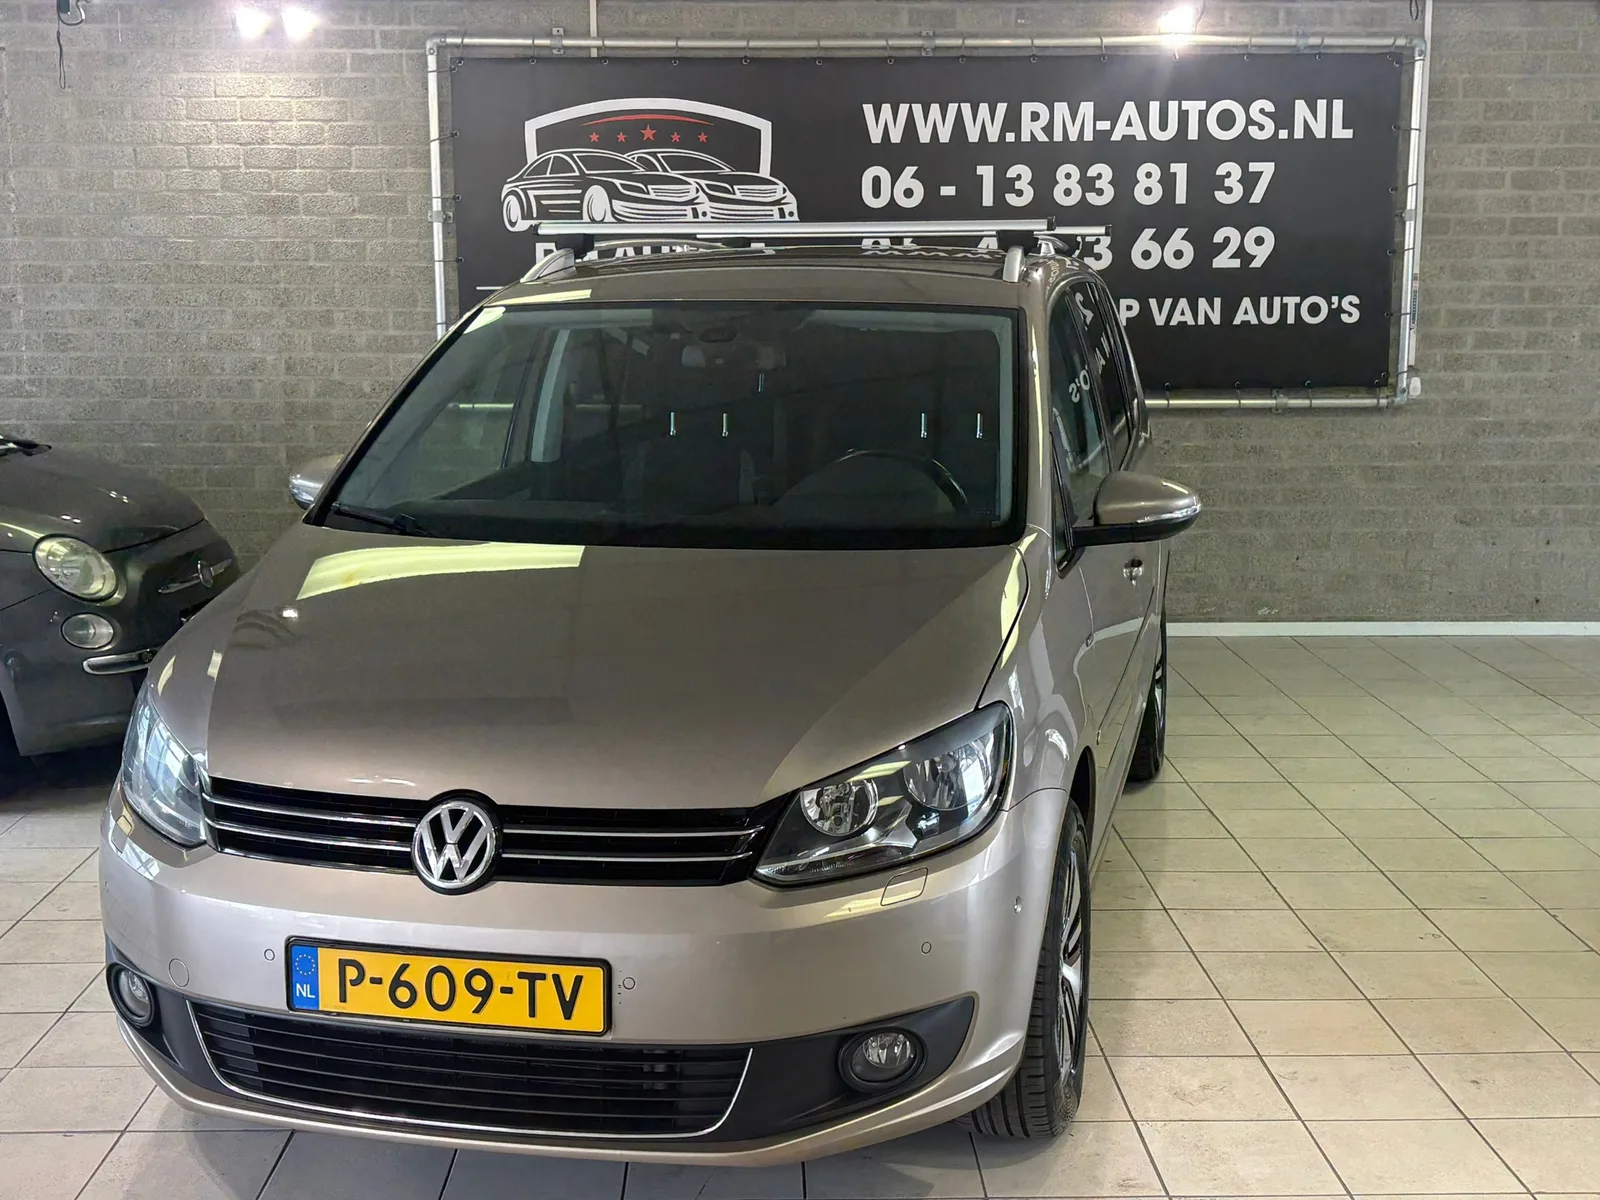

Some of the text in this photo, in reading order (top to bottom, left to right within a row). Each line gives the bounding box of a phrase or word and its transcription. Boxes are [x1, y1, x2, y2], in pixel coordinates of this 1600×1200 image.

[862, 98, 1354, 144] WWW.RM-AUTOS.NL
[861, 165, 925, 209] 06
[976, 163, 1035, 207] 13
[1052, 162, 1115, 207] 83
[1133, 162, 1188, 206] 81
[1213, 161, 1276, 205] 37
[1130, 227, 1195, 270] 66
[1212, 225, 1276, 269] 29
[1148, 297, 1222, 326] VAN
[1232, 294, 1361, 325] AUTO'S
[296, 982, 316, 999] NL
[337, 957, 584, 1021] P-609-TV
